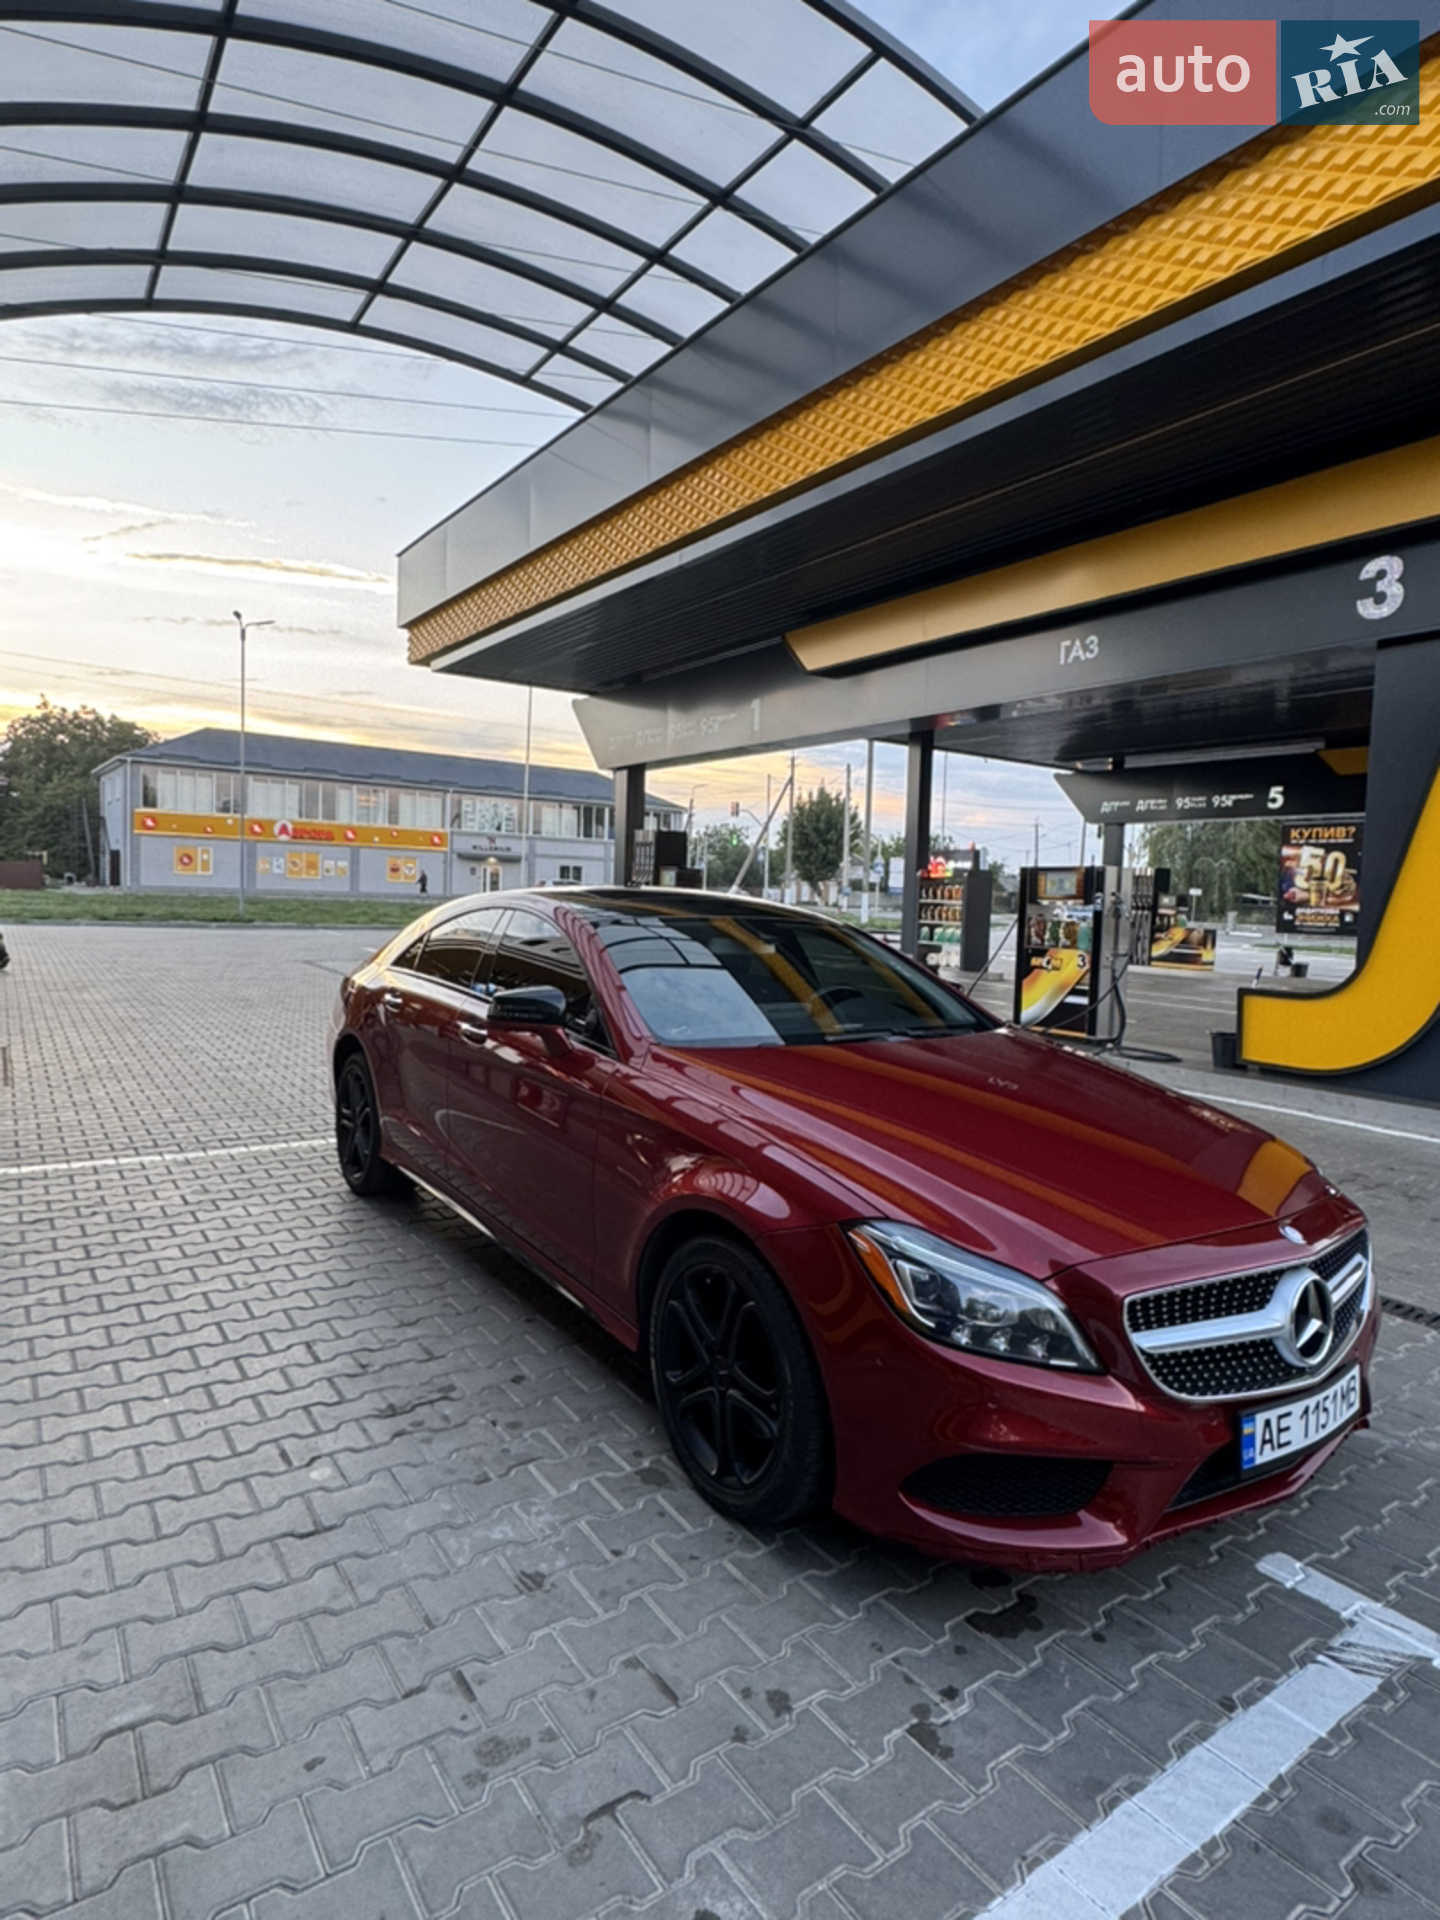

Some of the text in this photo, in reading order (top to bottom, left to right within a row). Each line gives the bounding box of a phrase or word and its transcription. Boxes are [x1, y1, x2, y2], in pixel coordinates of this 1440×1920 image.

[1355, 554, 1405, 620] 3
[1059, 634, 1099, 665] ГАЗ
[749, 698, 761, 732] 1
[1266, 785, 1285, 810] 5
[1290, 826, 1356, 839] КУПИВ?
[1294, 845, 1346, 893] 50
[1076, 953, 1087, 969] 3
[1259, 1374, 1357, 1457] AE 1151 MB
